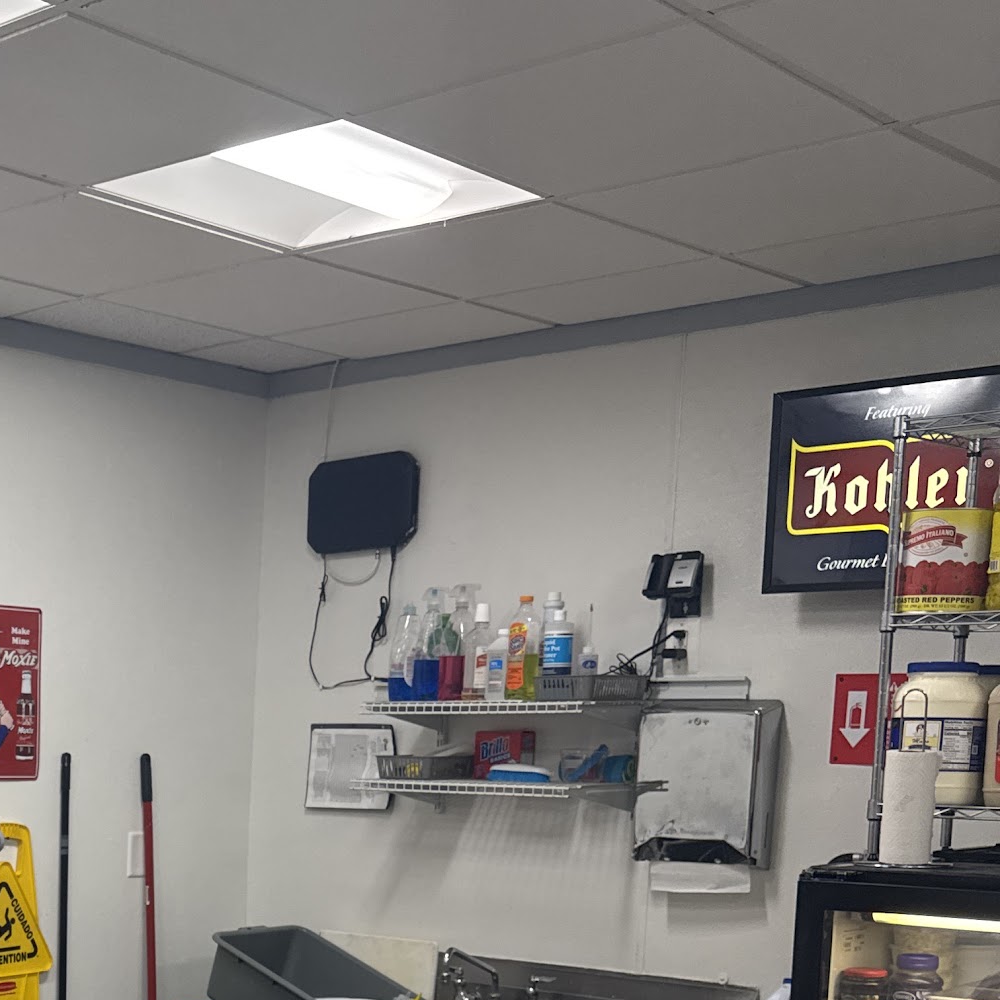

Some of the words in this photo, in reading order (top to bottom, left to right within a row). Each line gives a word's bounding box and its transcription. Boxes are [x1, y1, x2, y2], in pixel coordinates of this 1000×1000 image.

[865, 404, 931, 421] Featuring
[817, 556, 879, 571] Gourmet
[11, 627, 30, 635] Make
[11, 637, 30, 645] Mine
[480, 737, 509, 759] Brillo
[12, 899, 32, 940] CUIDADO
